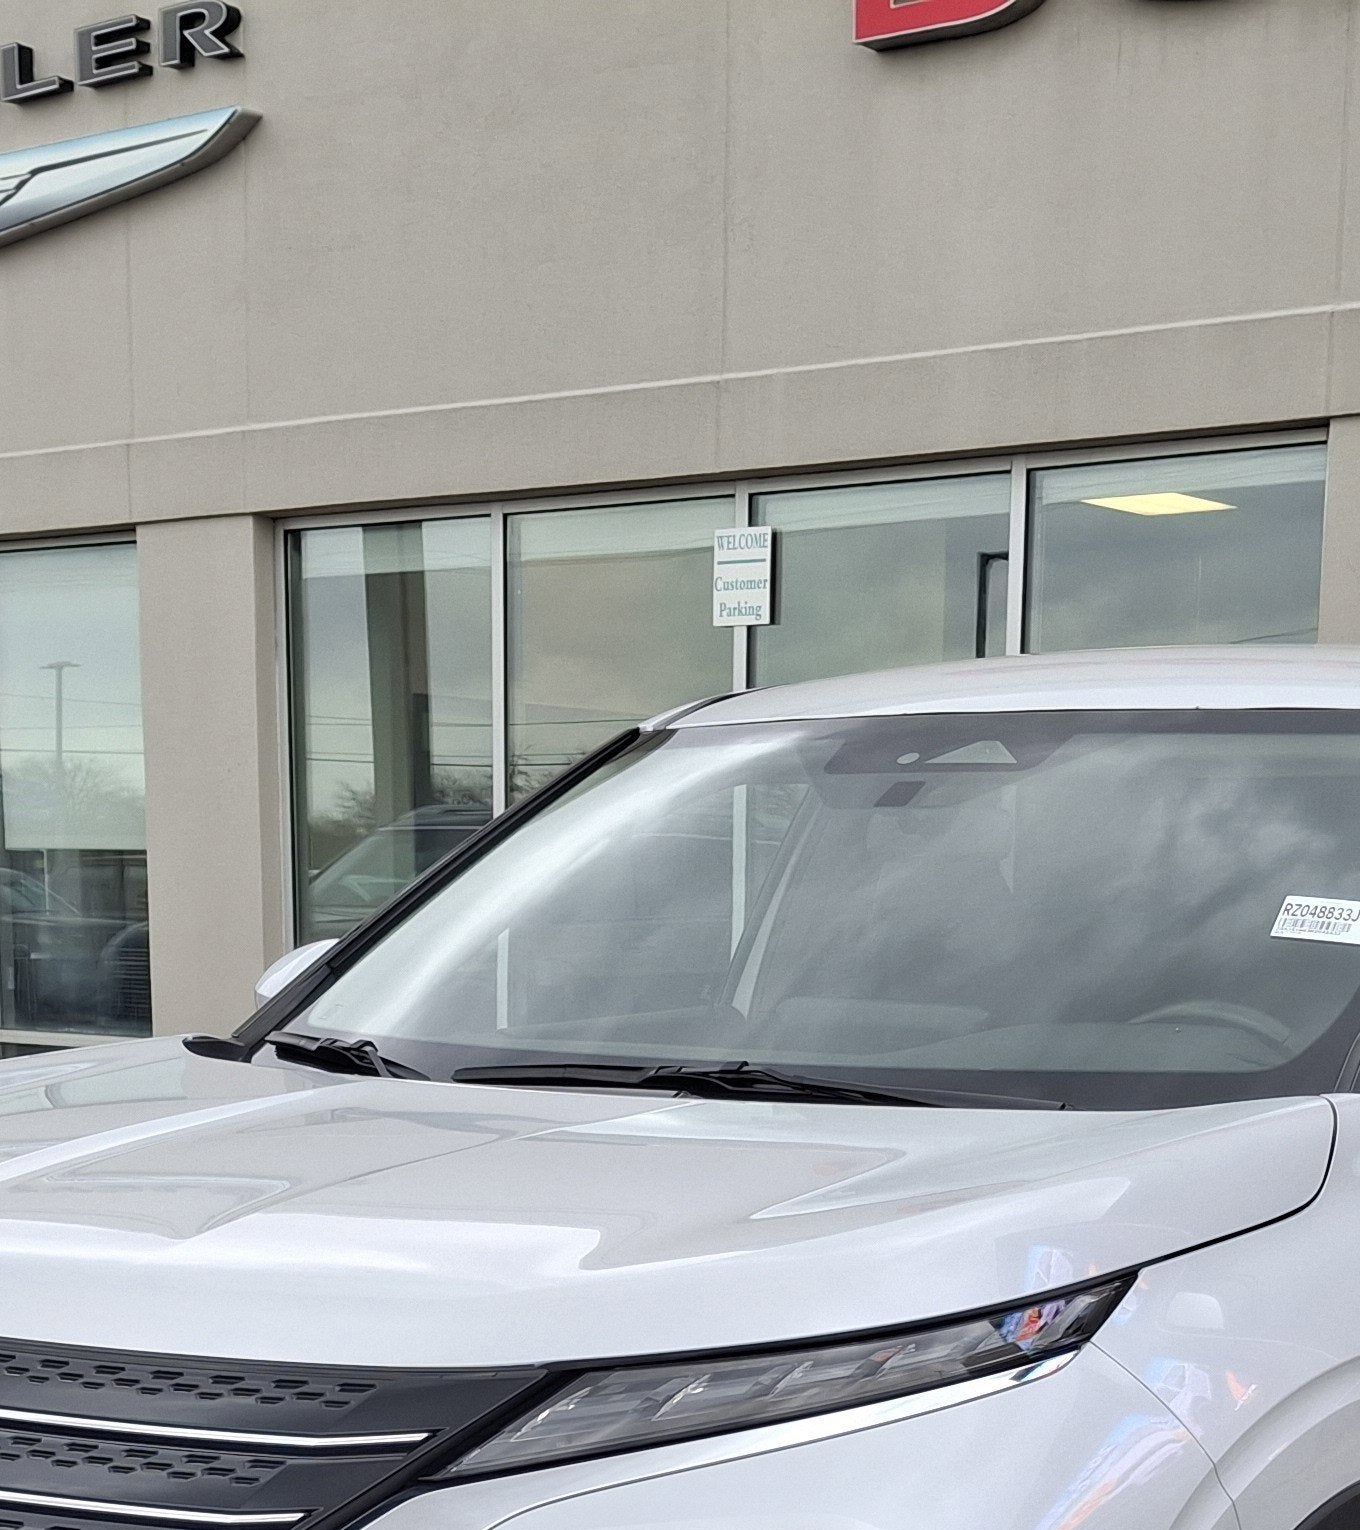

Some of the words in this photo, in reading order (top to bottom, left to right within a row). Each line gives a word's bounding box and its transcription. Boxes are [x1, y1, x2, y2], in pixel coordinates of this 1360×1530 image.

[717, 533, 768, 551] WELCOME
[714, 577, 768, 592] Customer
[719, 601, 762, 620] Parking
